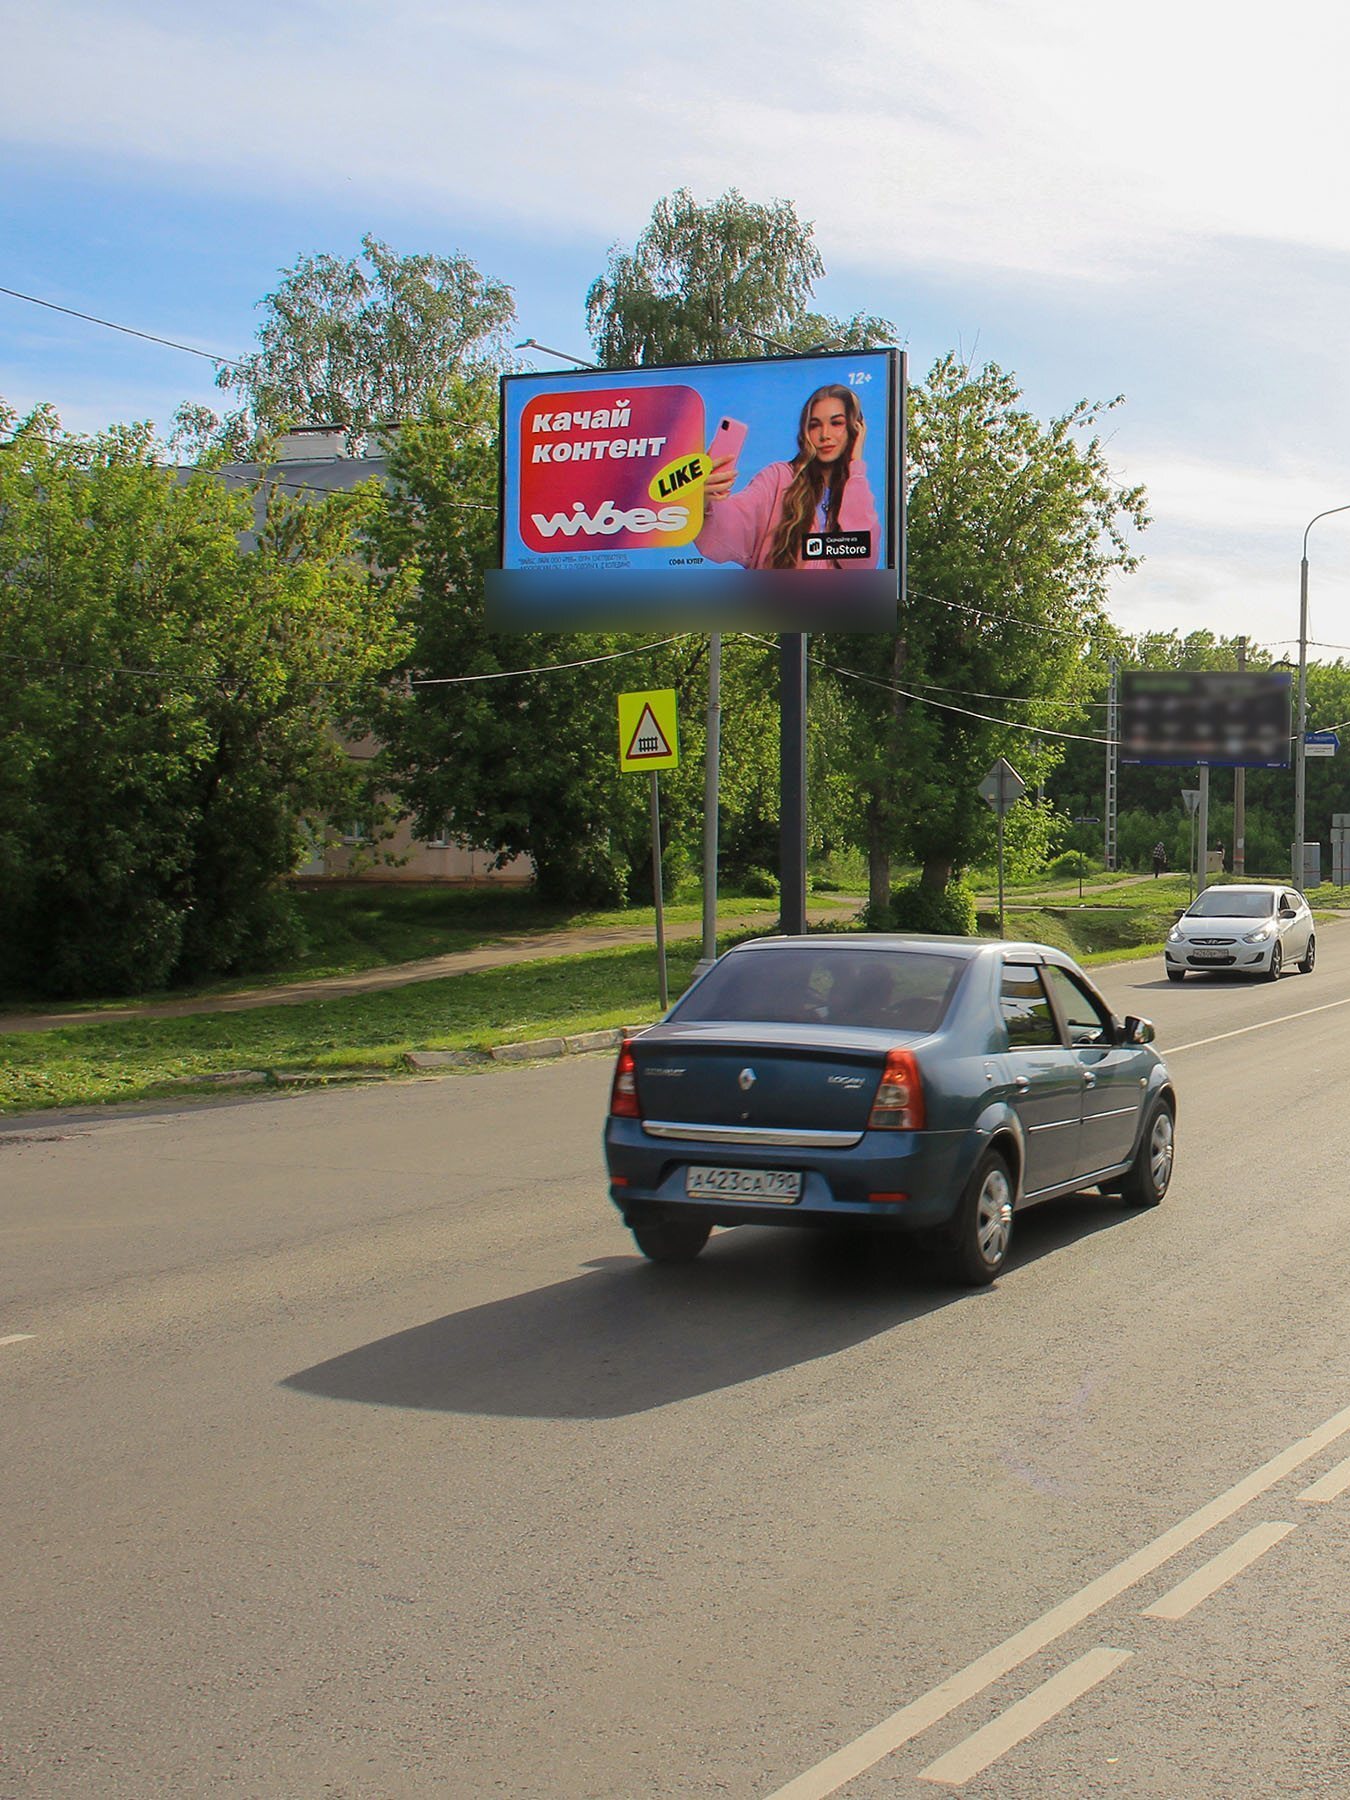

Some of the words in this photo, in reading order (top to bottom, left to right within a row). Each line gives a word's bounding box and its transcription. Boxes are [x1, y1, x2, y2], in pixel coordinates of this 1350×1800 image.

[848, 372, 872, 385] 12+
[532, 399, 631, 433] качай
[532, 437, 667, 464] контент
[658, 458, 703, 498] LIKE
[531, 500, 690, 538] wibes
[826, 545, 867, 556] RuStore
